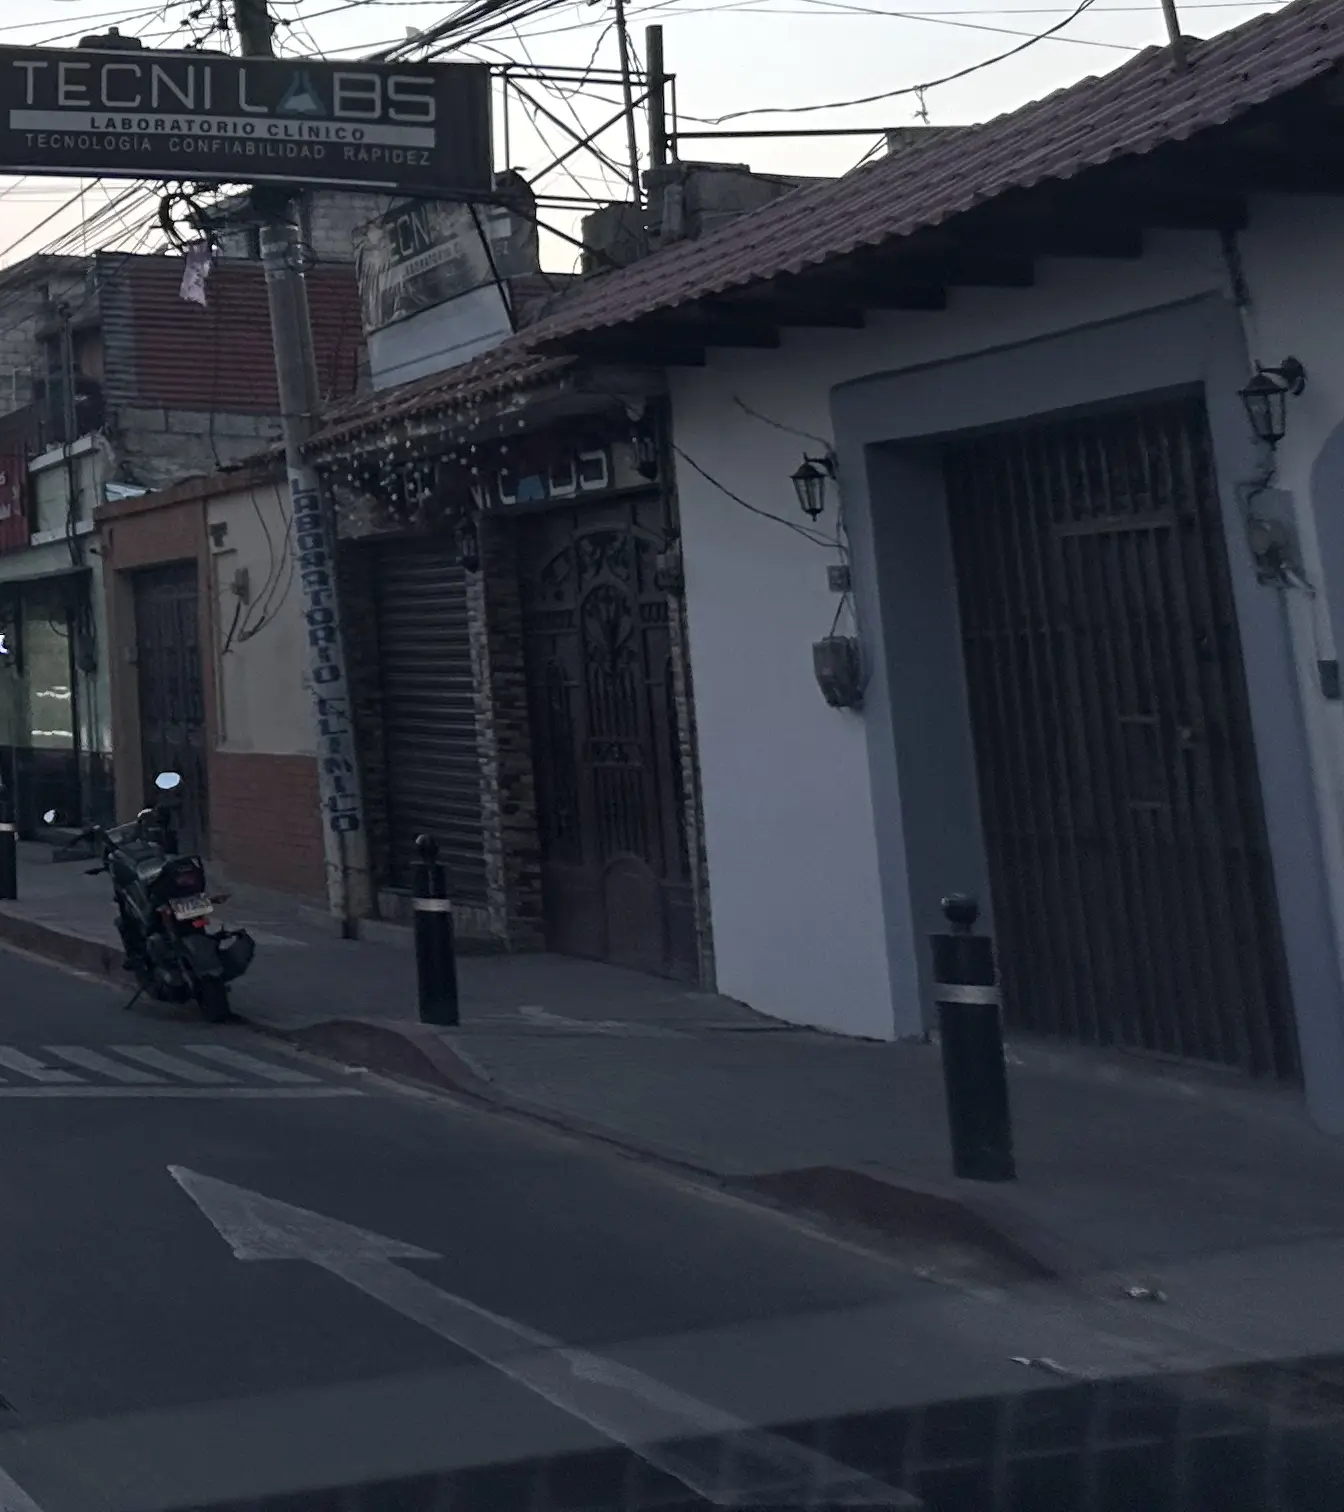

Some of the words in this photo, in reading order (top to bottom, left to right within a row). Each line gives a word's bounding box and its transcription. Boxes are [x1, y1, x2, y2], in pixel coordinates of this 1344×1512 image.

[13, 60, 212, 110] TECNI
[90, 116, 256, 136] LABORATORIO
[268, 121, 365, 142] CLÍNICO
[25, 133, 152, 152] TECNOLOGÍA
[169, 138, 326, 160] CONFIABILIDAD
